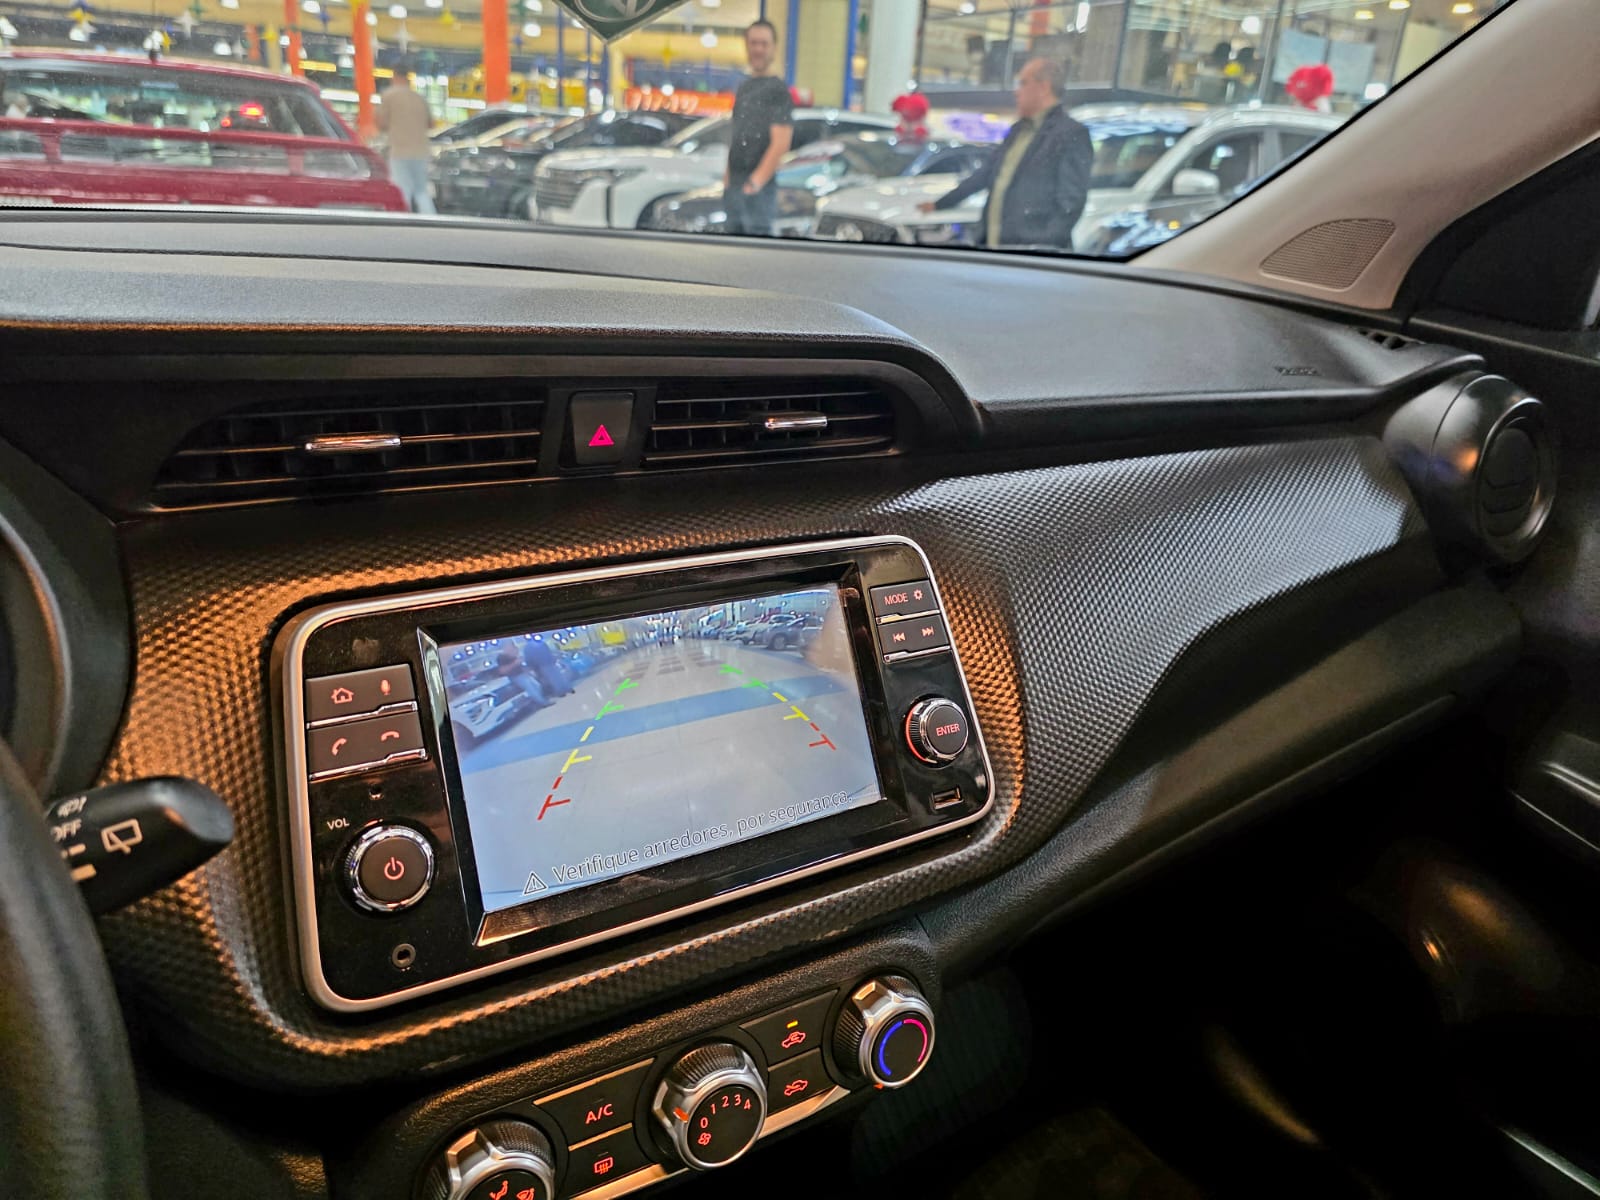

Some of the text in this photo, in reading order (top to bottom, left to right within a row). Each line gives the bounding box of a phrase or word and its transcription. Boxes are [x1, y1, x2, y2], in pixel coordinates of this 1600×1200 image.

[884, 592, 909, 605] MODE
[935, 723, 961, 737] ENTER
[326, 817, 350, 830] VOL
[552, 789, 853, 884] Verifique arredores, por segurança.
[710, 1103, 717, 1115] 1
[721, 1095, 730, 1108] 2
[733, 1093, 742, 1106] 3
[743, 1098, 752, 1110] 4
[585, 1103, 614, 1125] A/C
